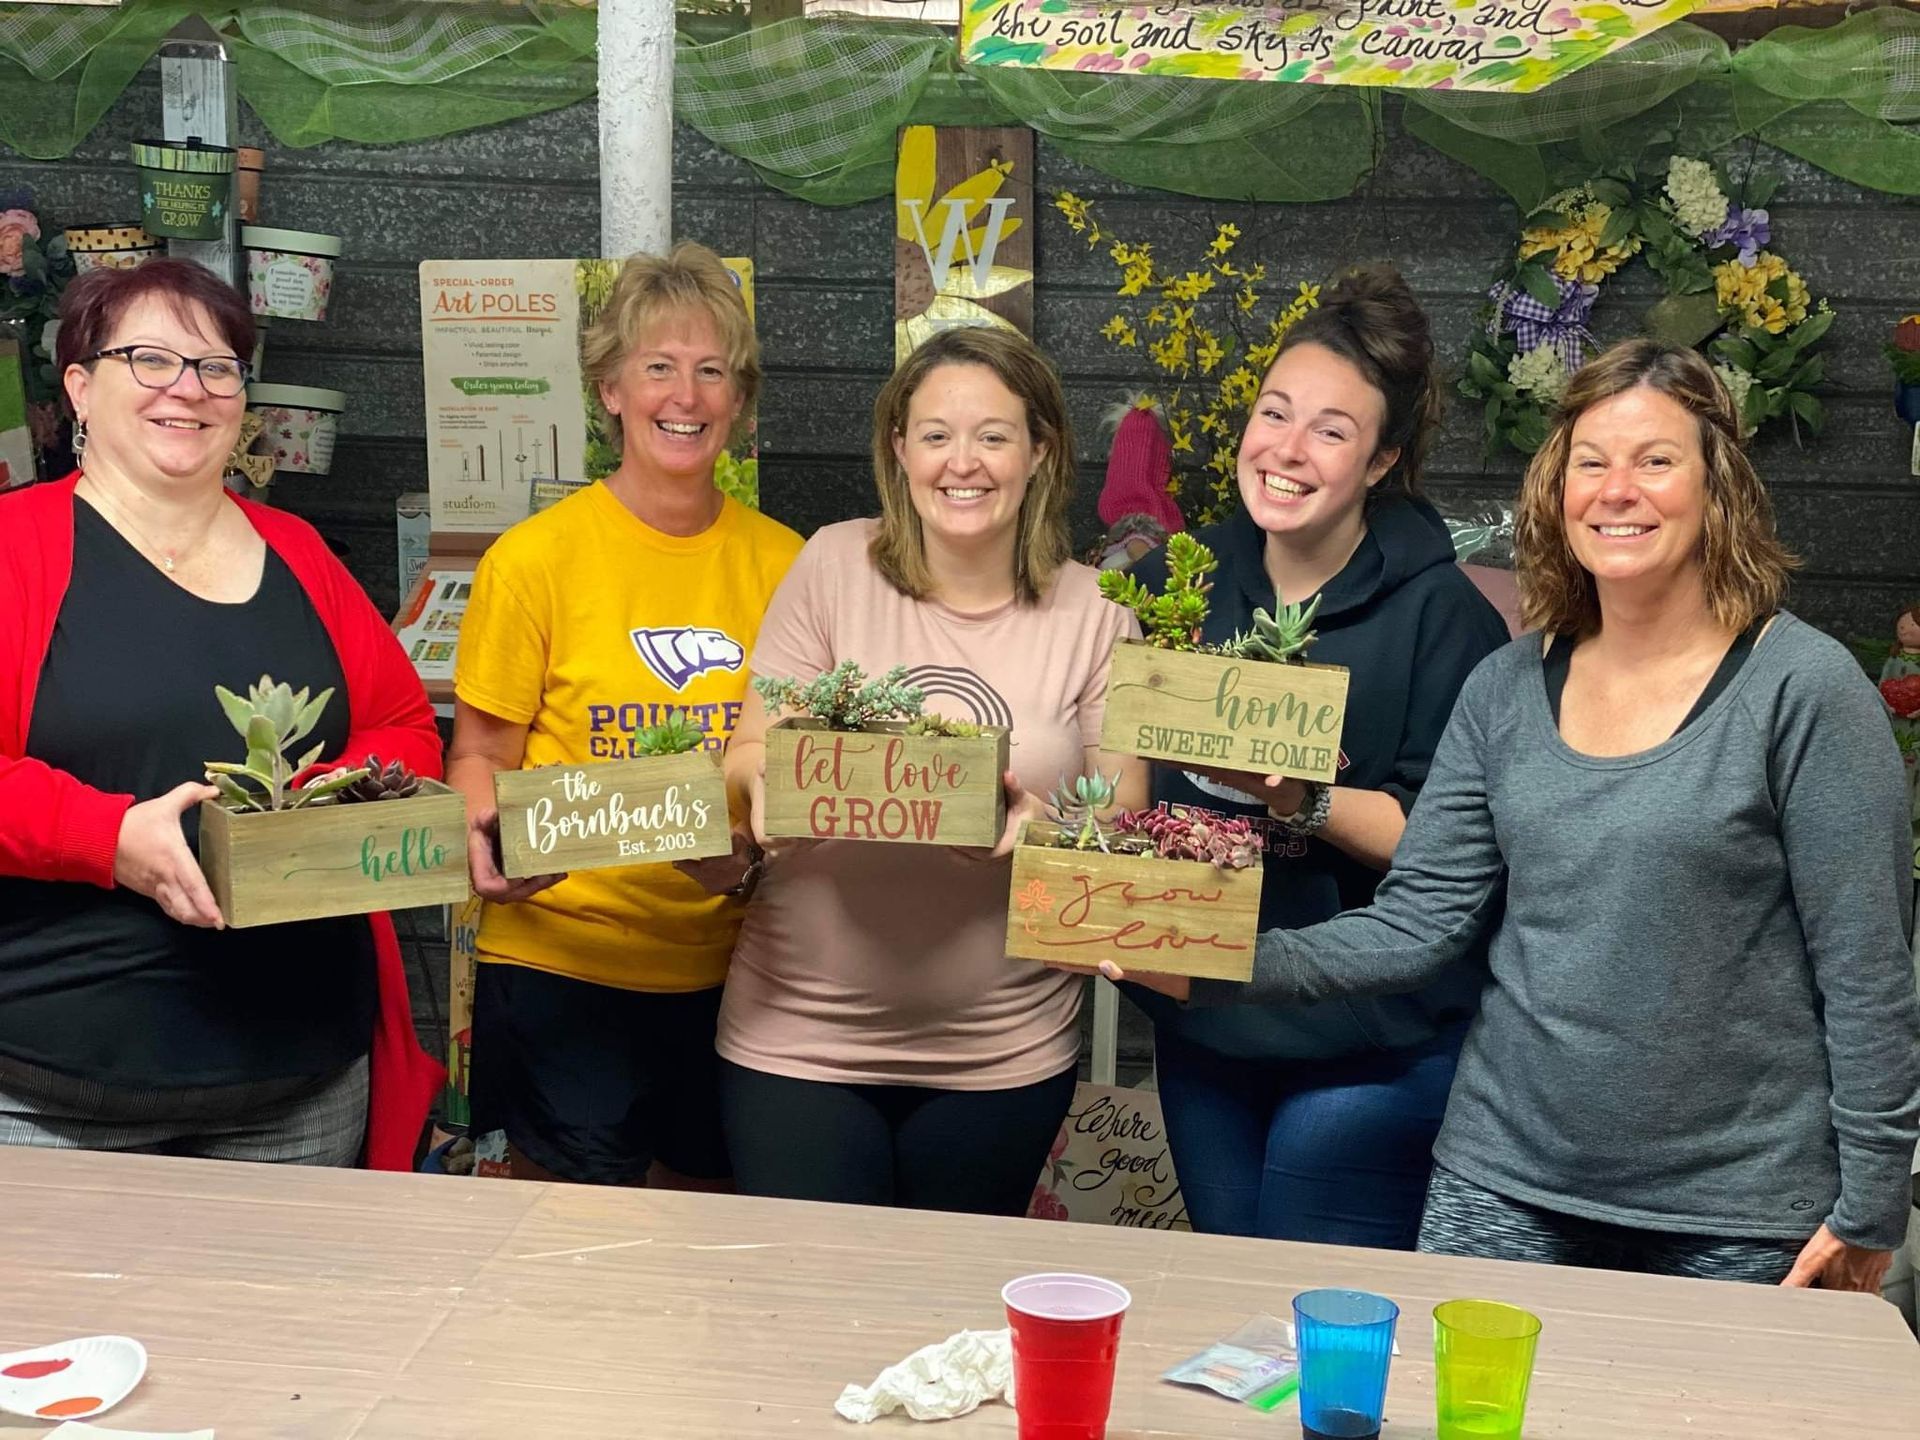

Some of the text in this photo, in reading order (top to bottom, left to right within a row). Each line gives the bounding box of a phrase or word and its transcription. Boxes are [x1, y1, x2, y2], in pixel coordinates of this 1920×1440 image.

[1472, 0, 1567, 35] and
[1056, 10, 1123, 46] soil
[1132, 17, 1202, 50] and
[1217, 20, 1288, 71] sky
[1360, 29, 1532, 65] canvas
[153, 181, 211, 199] THANKS
[161, 211, 202, 227] GROW
[902, 198, 1016, 290] W
[433, 278, 514, 287] SPECIAL-ORDER
[432, 290, 557, 314] Art POLES
[481, 326, 522, 334] BEAUTIFUL
[463, 380, 540, 393] Order yours today
[588, 702, 743, 733] POINTE
[1113, 666, 1341, 737] home
[589, 736, 645, 760] CLU
[795, 735, 968, 793] let love
[1137, 724, 1332, 773] SWEET HOME
[551, 770, 601, 802] the
[526, 783, 712, 854] Bornbach's
[810, 796, 942, 841] GROW
[284, 826, 449, 881] hello
[618, 832, 696, 857] Est. 2003
[1058, 875, 1223, 927] grow
[1036, 920, 1247, 950] love
[1067, 1096, 1160, 1142] Where
[1073, 1149, 1168, 1190] good
[1110, 1190, 1190, 1230] meet
